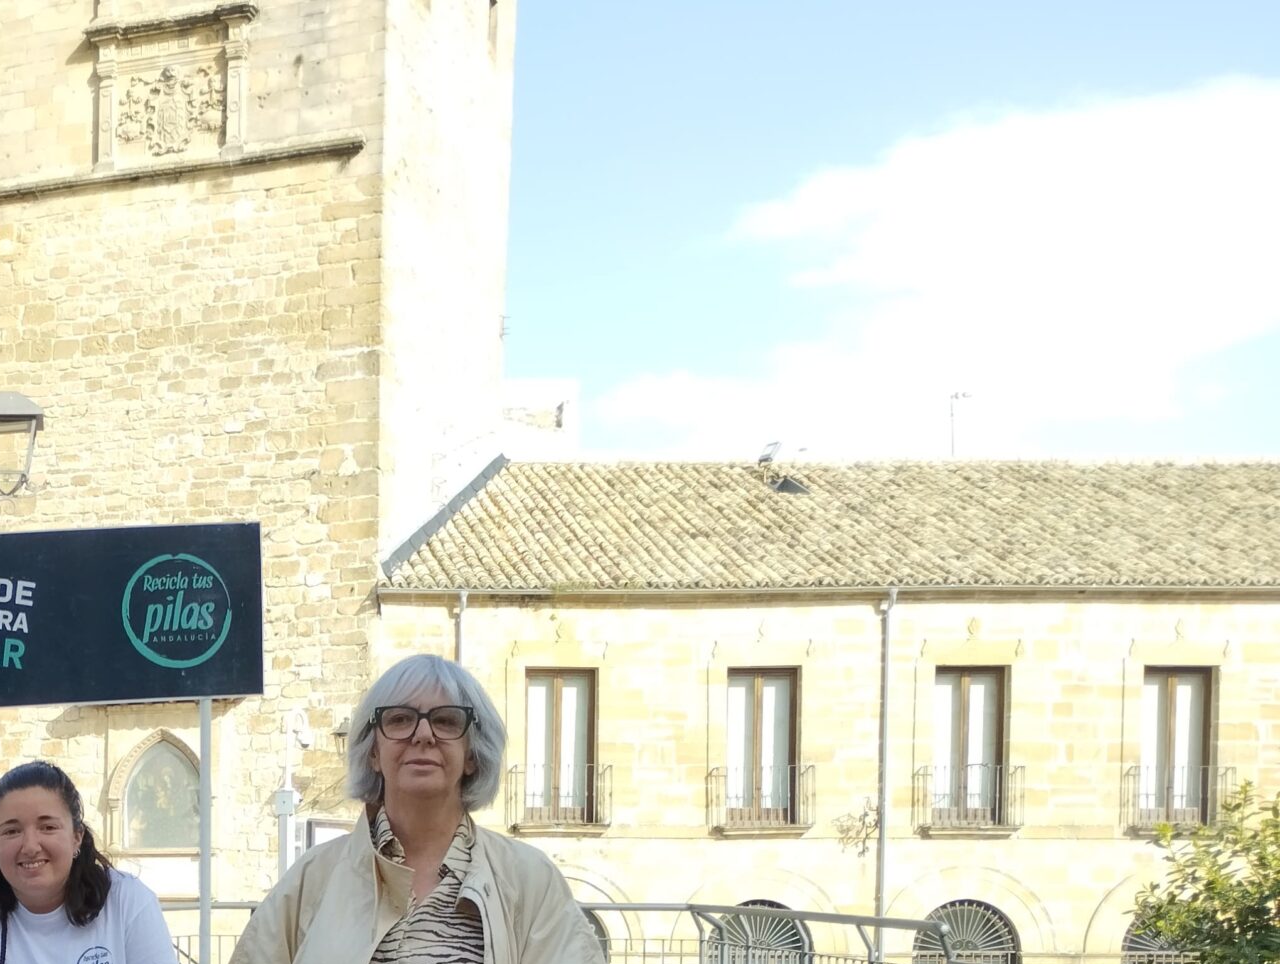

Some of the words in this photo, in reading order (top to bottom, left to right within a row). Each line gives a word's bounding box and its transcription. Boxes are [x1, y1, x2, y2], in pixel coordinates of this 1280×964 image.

[143, 571, 189, 592] Recicla
[192, 573, 214, 589] tus
[142, 590, 215, 644] pilas
